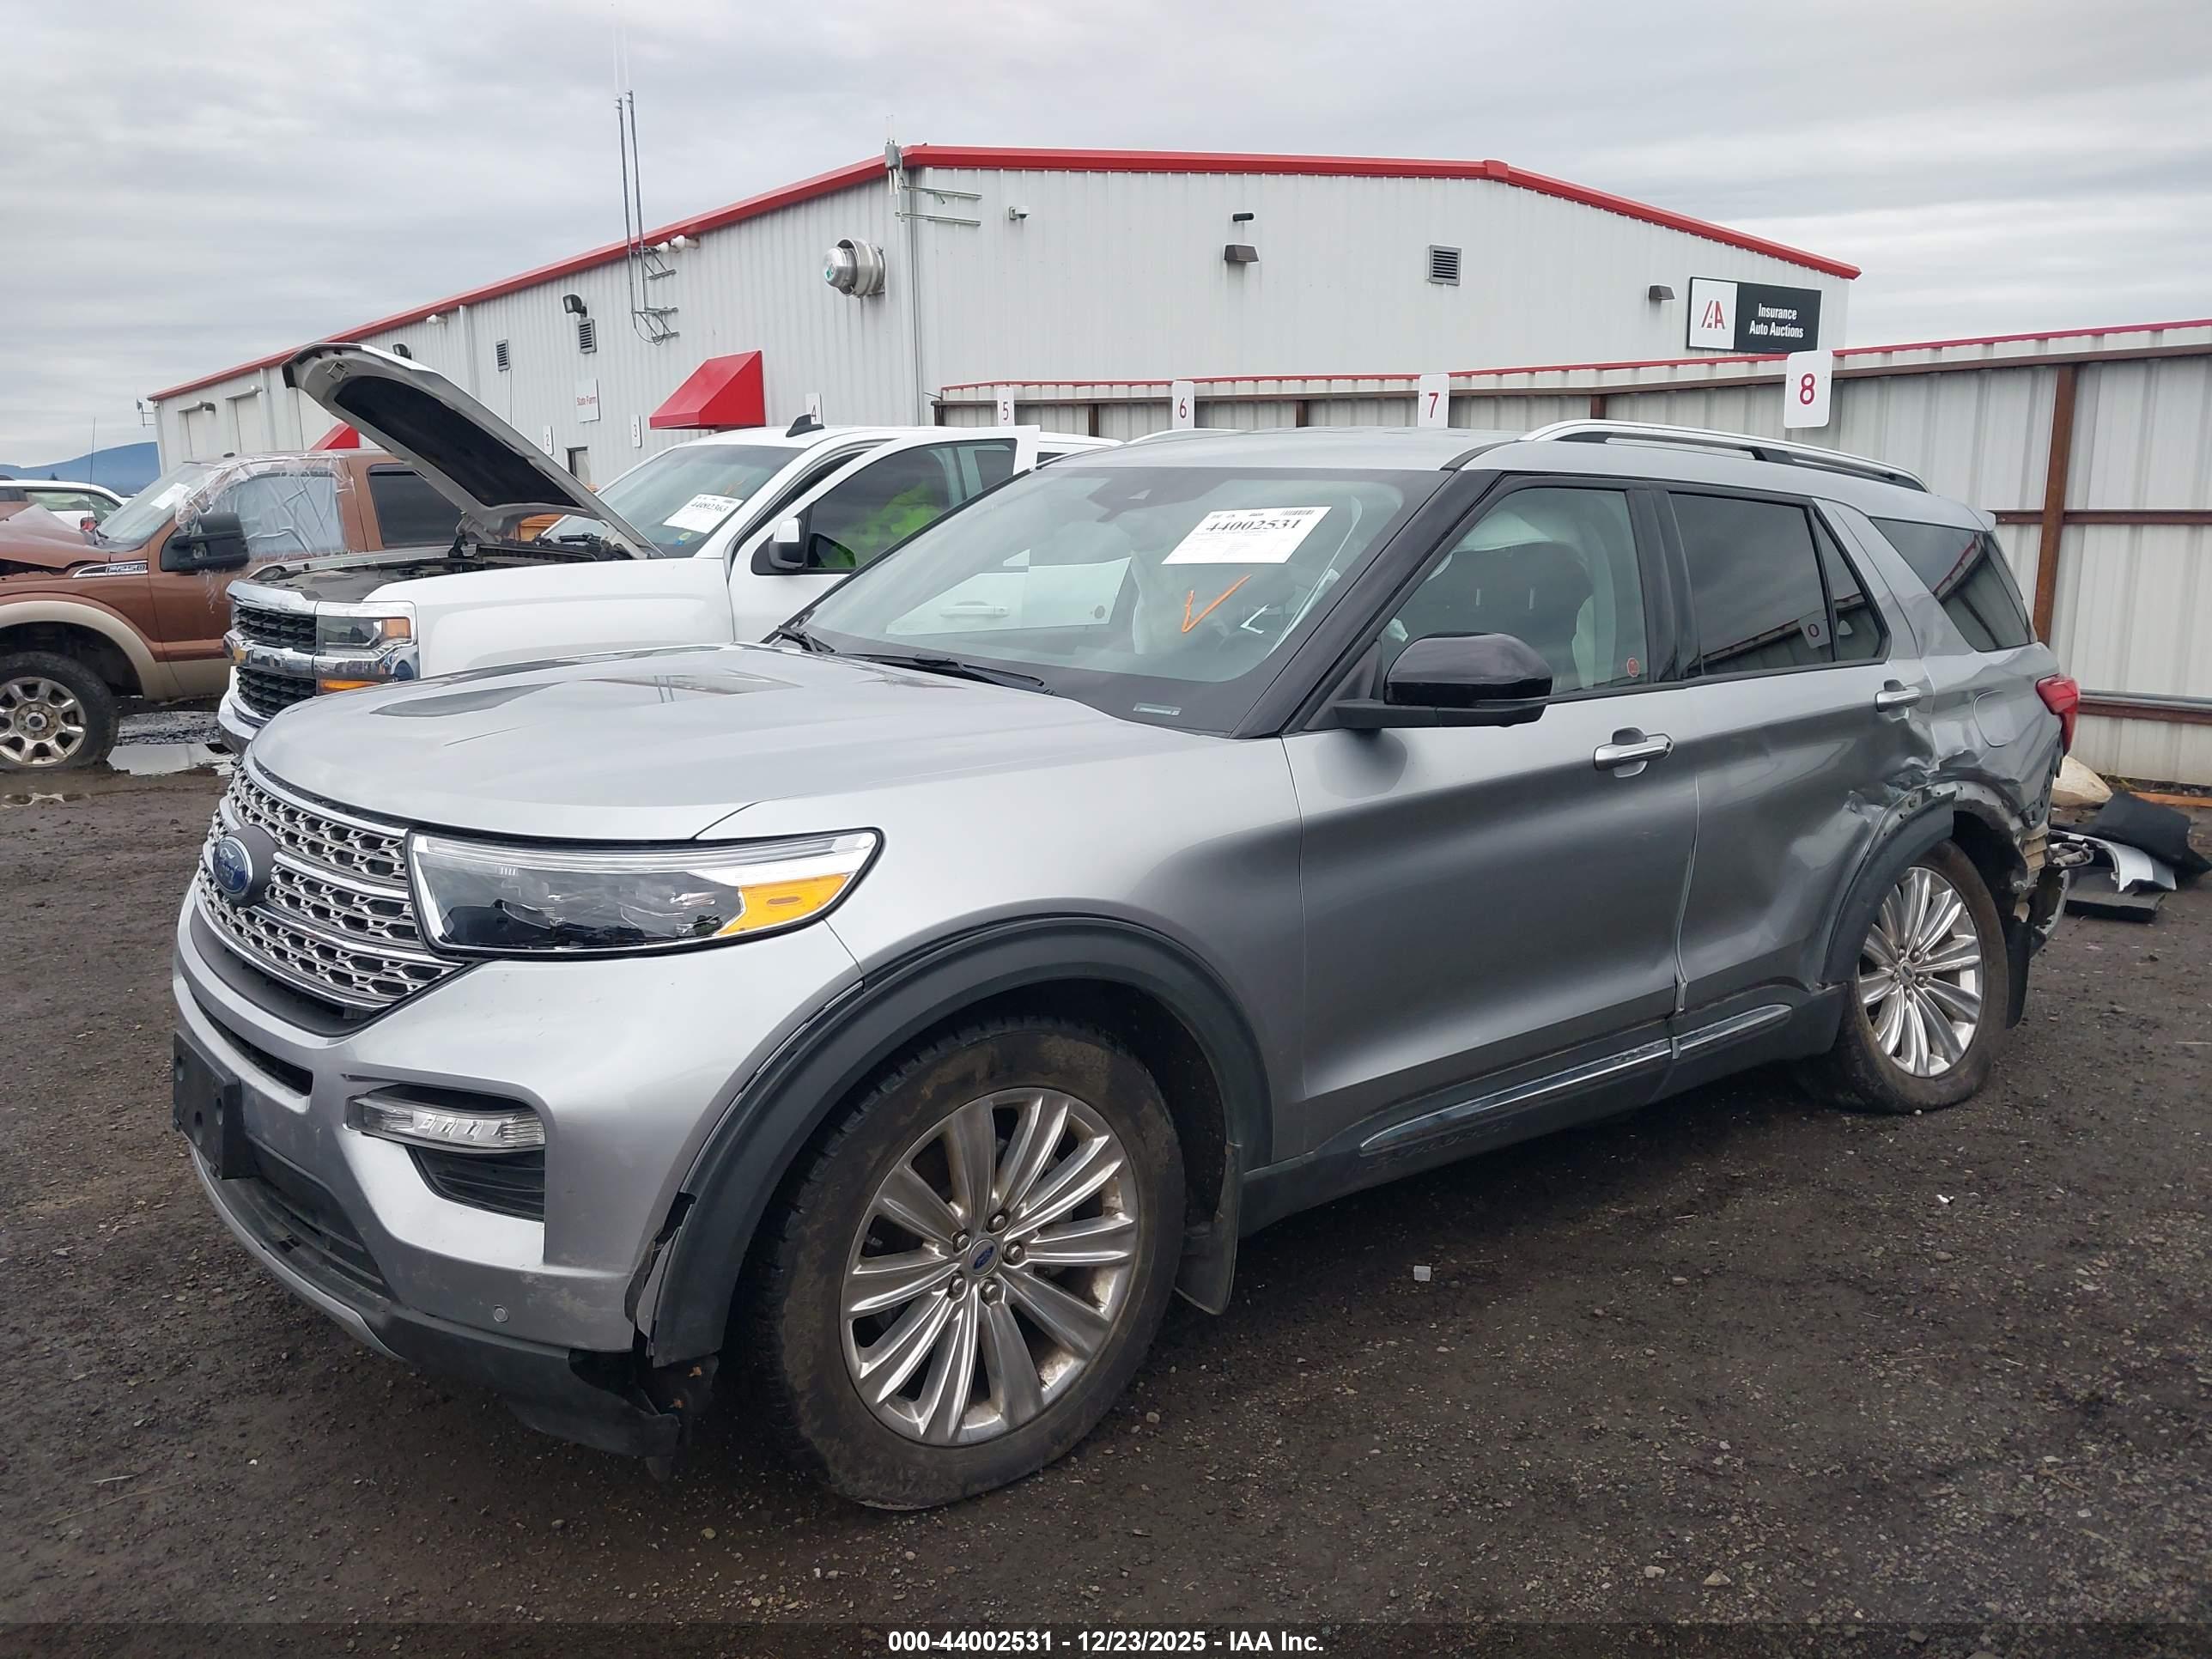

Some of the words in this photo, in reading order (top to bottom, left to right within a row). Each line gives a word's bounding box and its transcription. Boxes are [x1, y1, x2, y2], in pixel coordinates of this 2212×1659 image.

[1758, 302, 1798, 320] Insurance
[1749, 319, 1769, 336] Auto
[1770, 321, 1804, 338] Auctions
[1799, 373, 1816, 405] 8
[810, 404, 817, 422] 4
[1002, 400, 1009, 421] 5
[1179, 397, 1188, 419] 6
[1428, 392, 1439, 419] 7
[1205, 518, 1303, 532] 44002531
